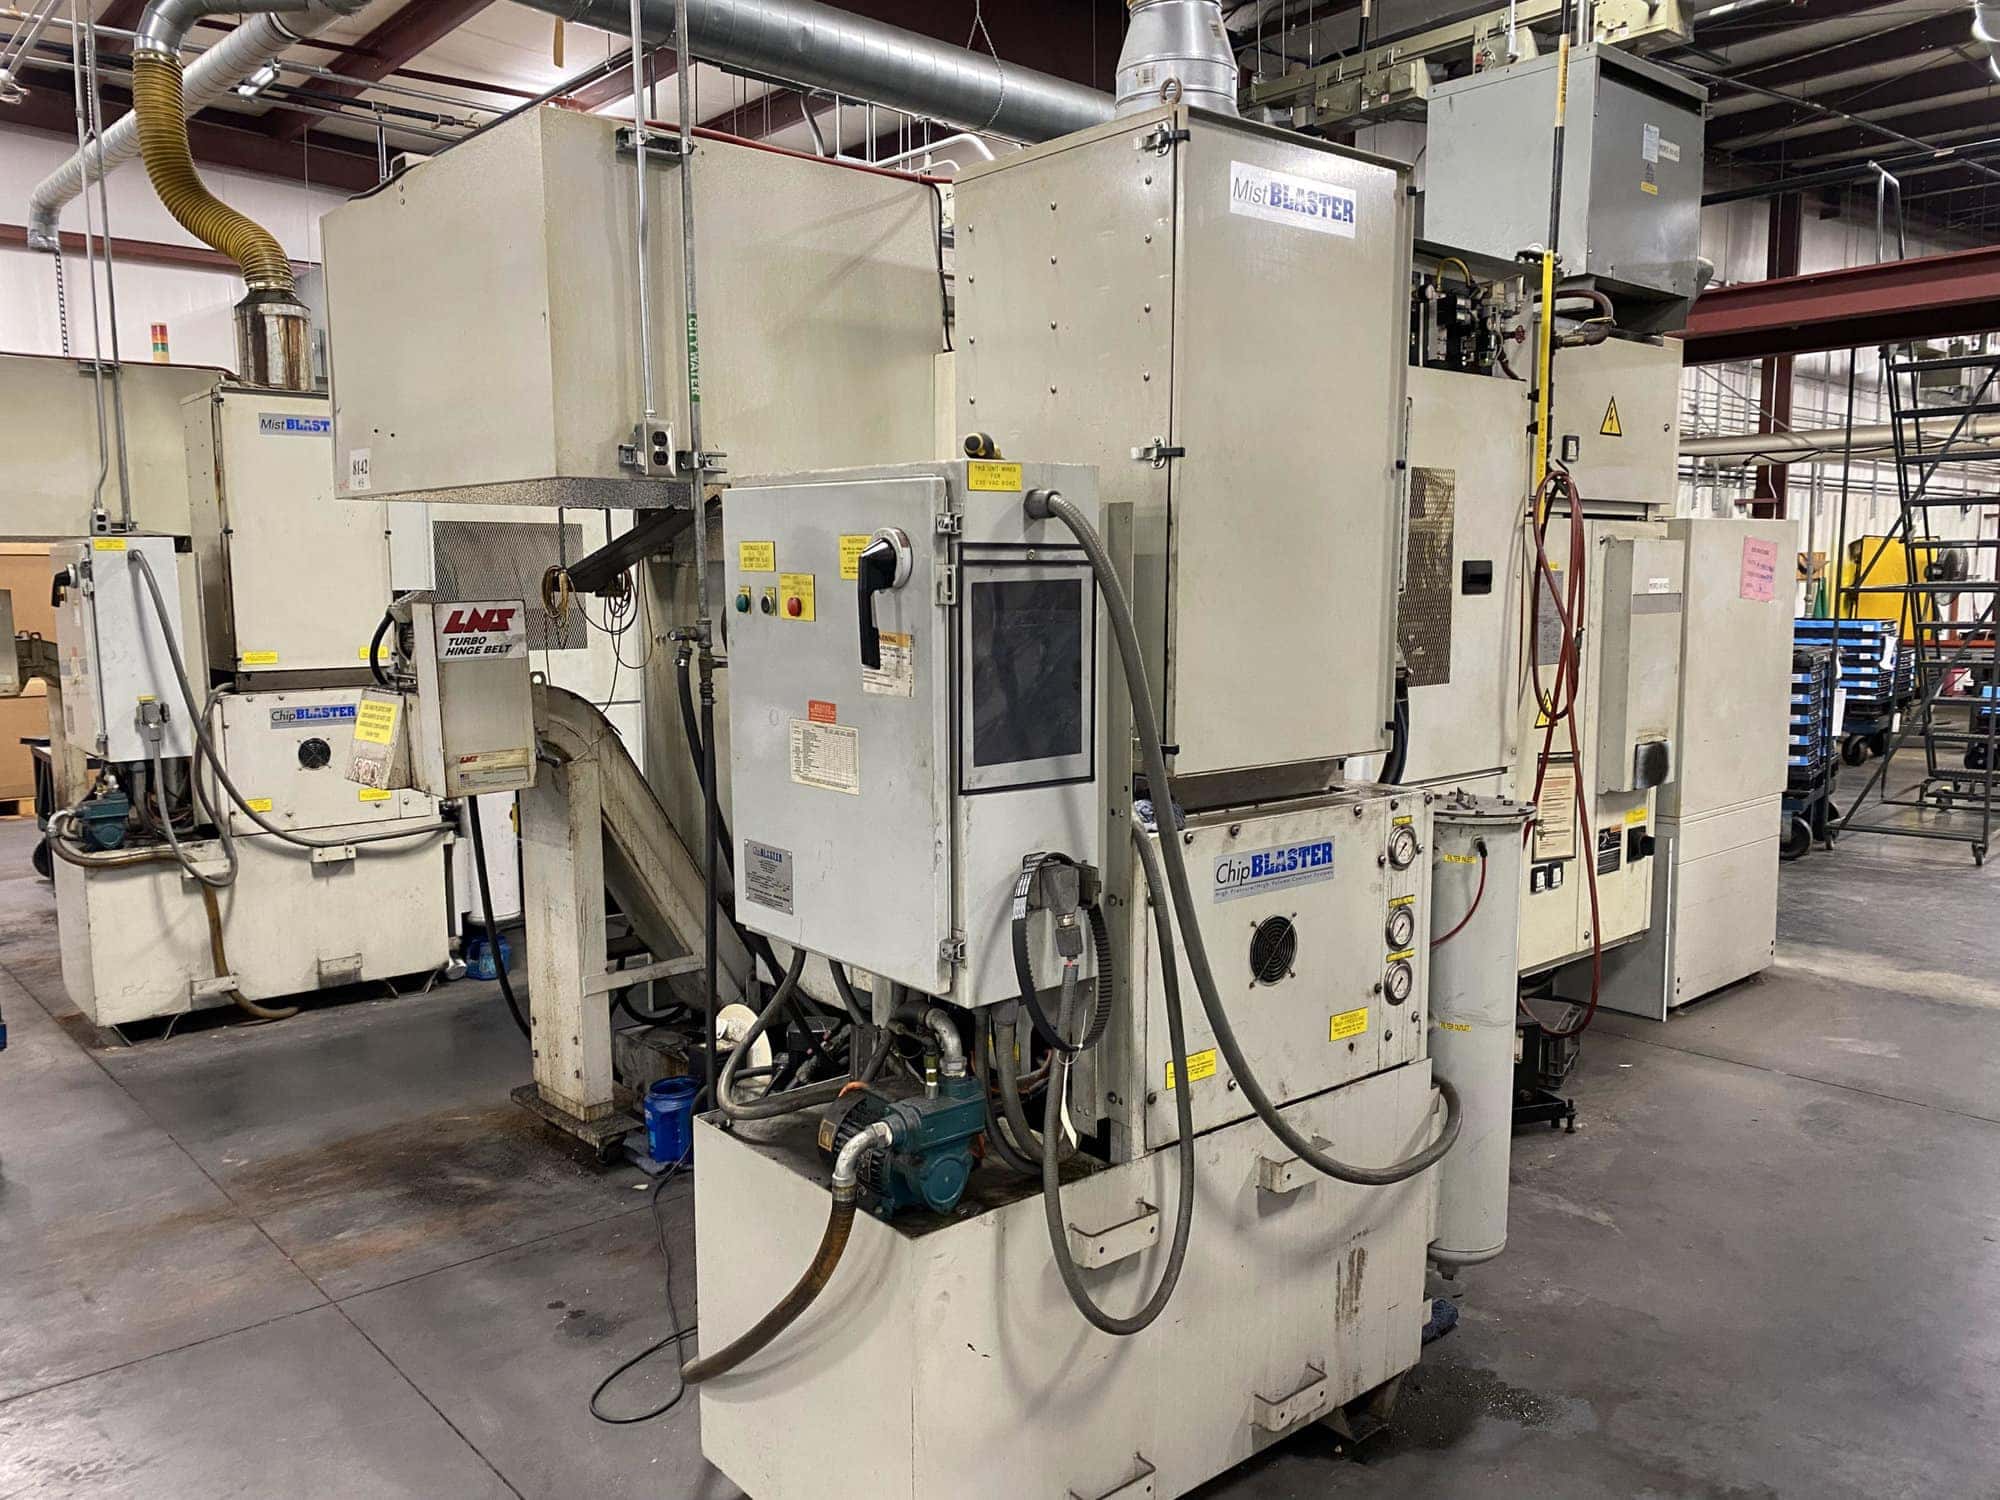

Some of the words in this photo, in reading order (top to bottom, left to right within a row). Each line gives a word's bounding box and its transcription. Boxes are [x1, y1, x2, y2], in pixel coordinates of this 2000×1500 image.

[688, 318, 698, 348] CITY
[690, 351, 700, 395] WATER
[260, 418, 331, 433] MistBLAST
[443, 608, 516, 634] LNS
[445, 646, 482, 657] HINGE
[483, 644, 512, 654] BELT
[448, 636, 487, 647] TURBO
